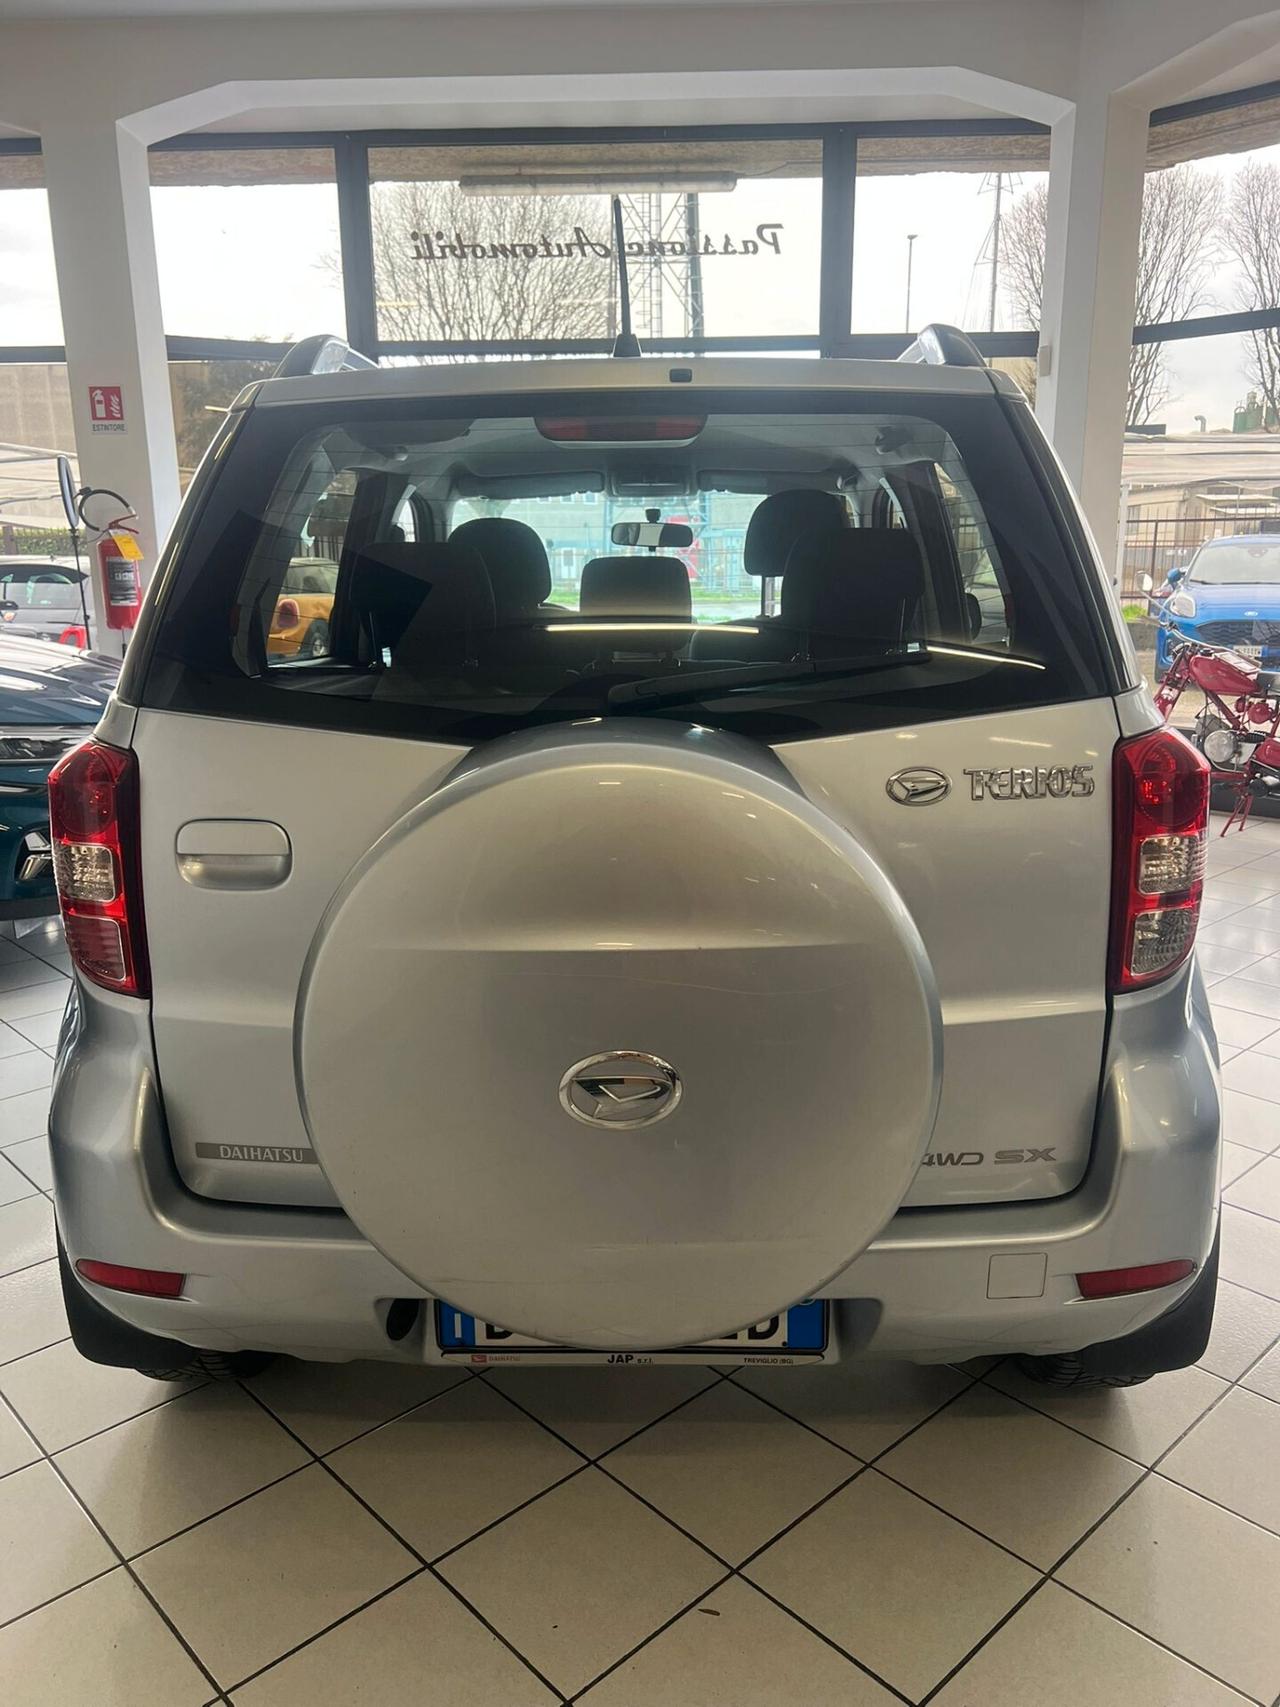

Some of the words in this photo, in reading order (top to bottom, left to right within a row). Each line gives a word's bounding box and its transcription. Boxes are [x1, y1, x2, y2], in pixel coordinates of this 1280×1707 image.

[92, 423, 125, 431] ESTINTORE
[963, 764, 1095, 801] TERIOS
[219, 1145, 303, 1162] DAIHATSU
[921, 1152, 984, 1166] 4WD
[994, 1147, 1056, 1165] SX
[607, 1354, 634, 1363] JAP
